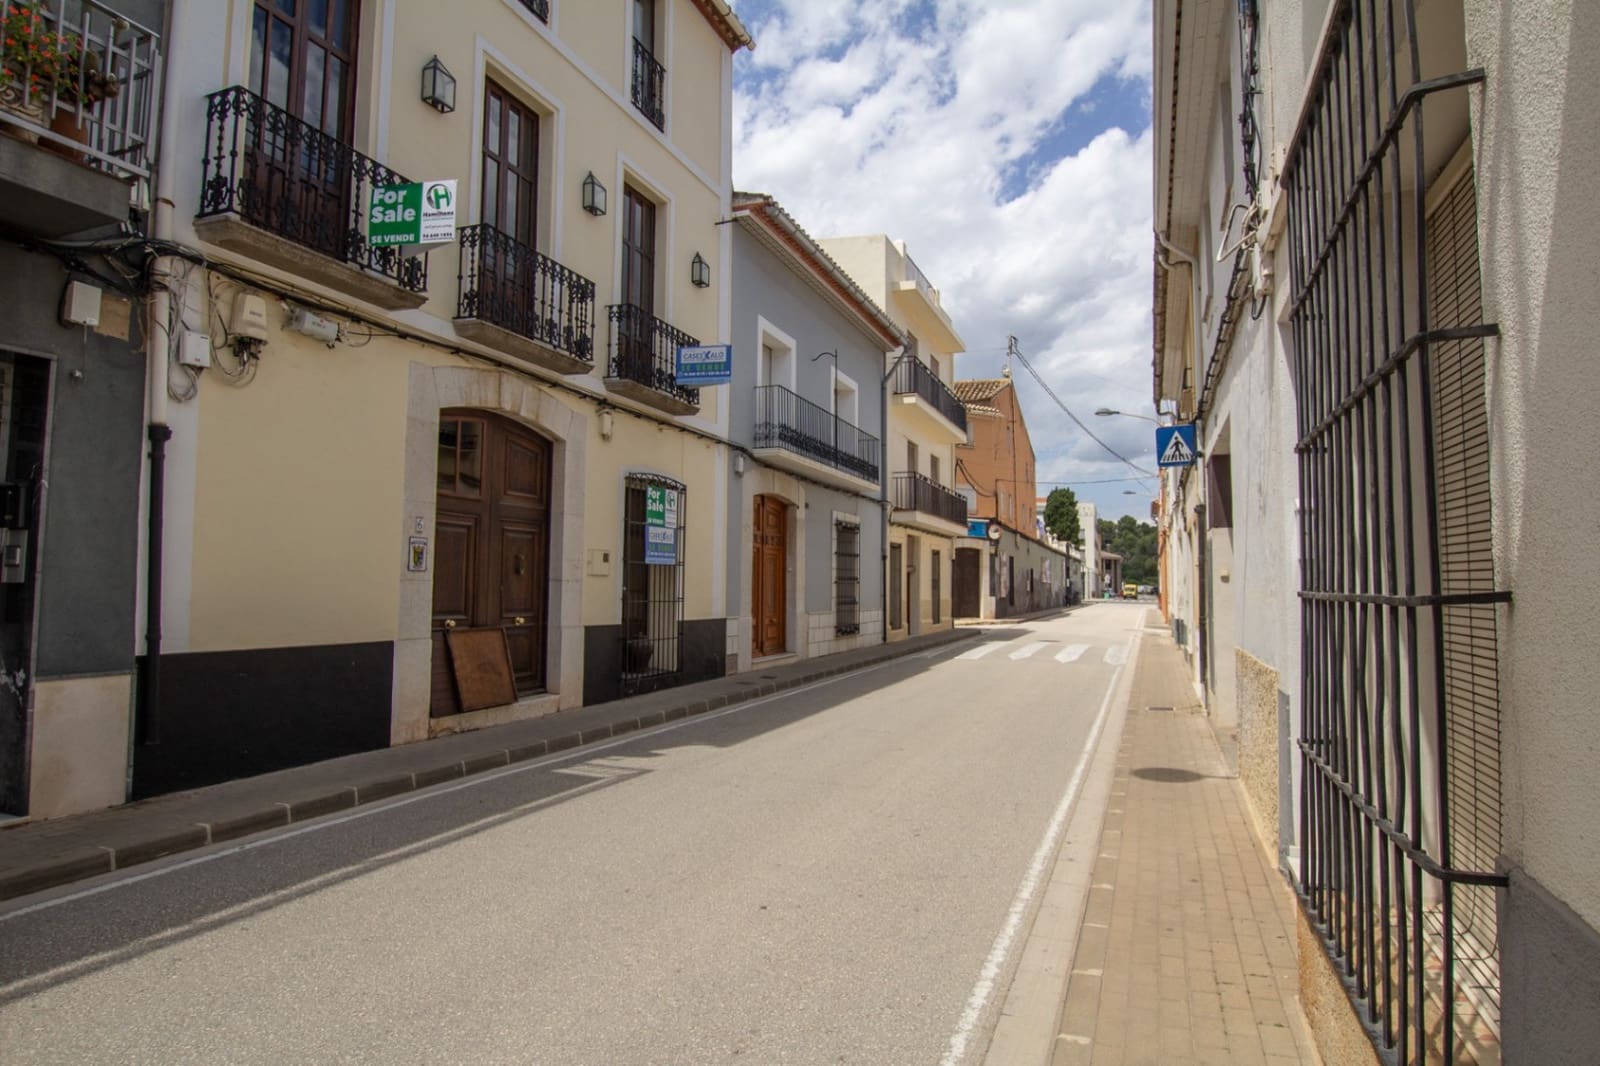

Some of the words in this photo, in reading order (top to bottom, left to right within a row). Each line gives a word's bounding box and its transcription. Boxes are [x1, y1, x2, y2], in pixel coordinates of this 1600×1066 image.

[373, 188, 407, 204] For
[371, 204, 416, 224] Sale
[371, 235, 382, 243] SE
[384, 234, 415, 242] VENDE
[647, 487, 661, 500] For
[647, 499, 664, 513] Sale
